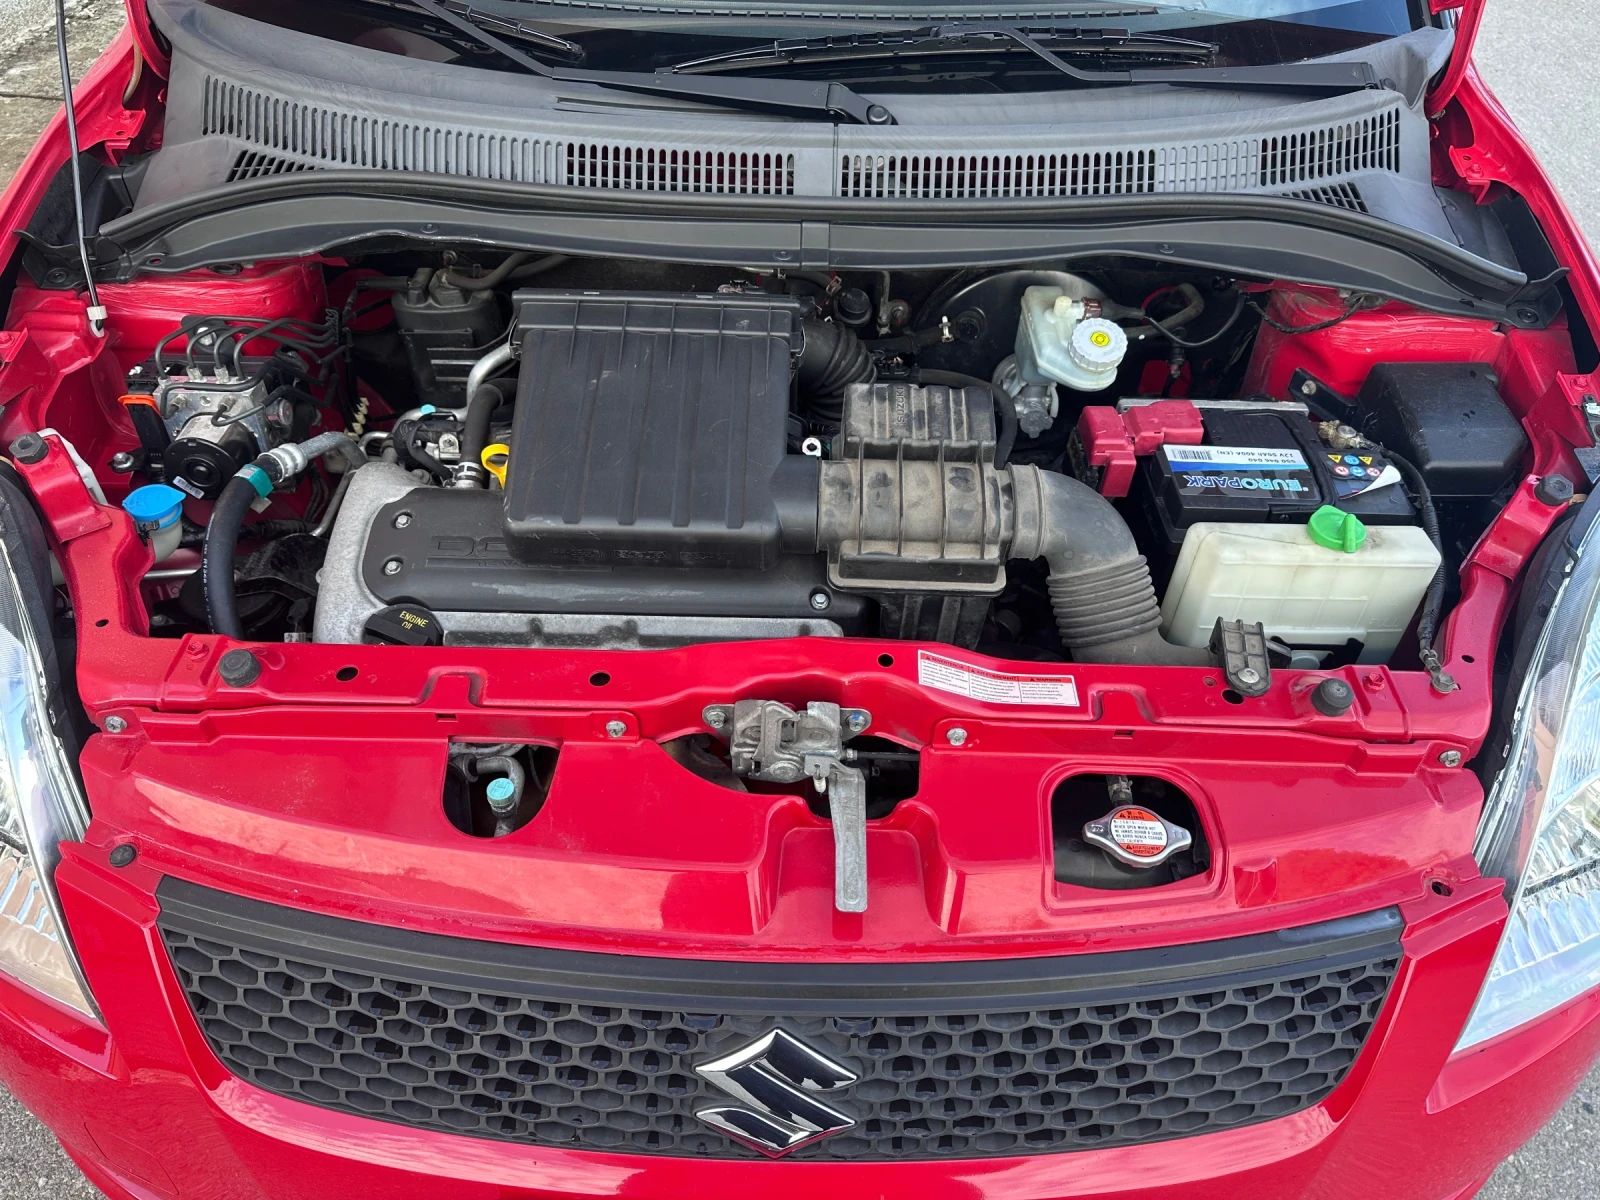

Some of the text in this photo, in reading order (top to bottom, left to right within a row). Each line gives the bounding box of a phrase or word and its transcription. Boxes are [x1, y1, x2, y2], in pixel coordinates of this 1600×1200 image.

[895, 387, 905, 424] SUZUKI
[1182, 474, 1308, 492] EUROPARK
[399, 610, 429, 628] ENGINE
